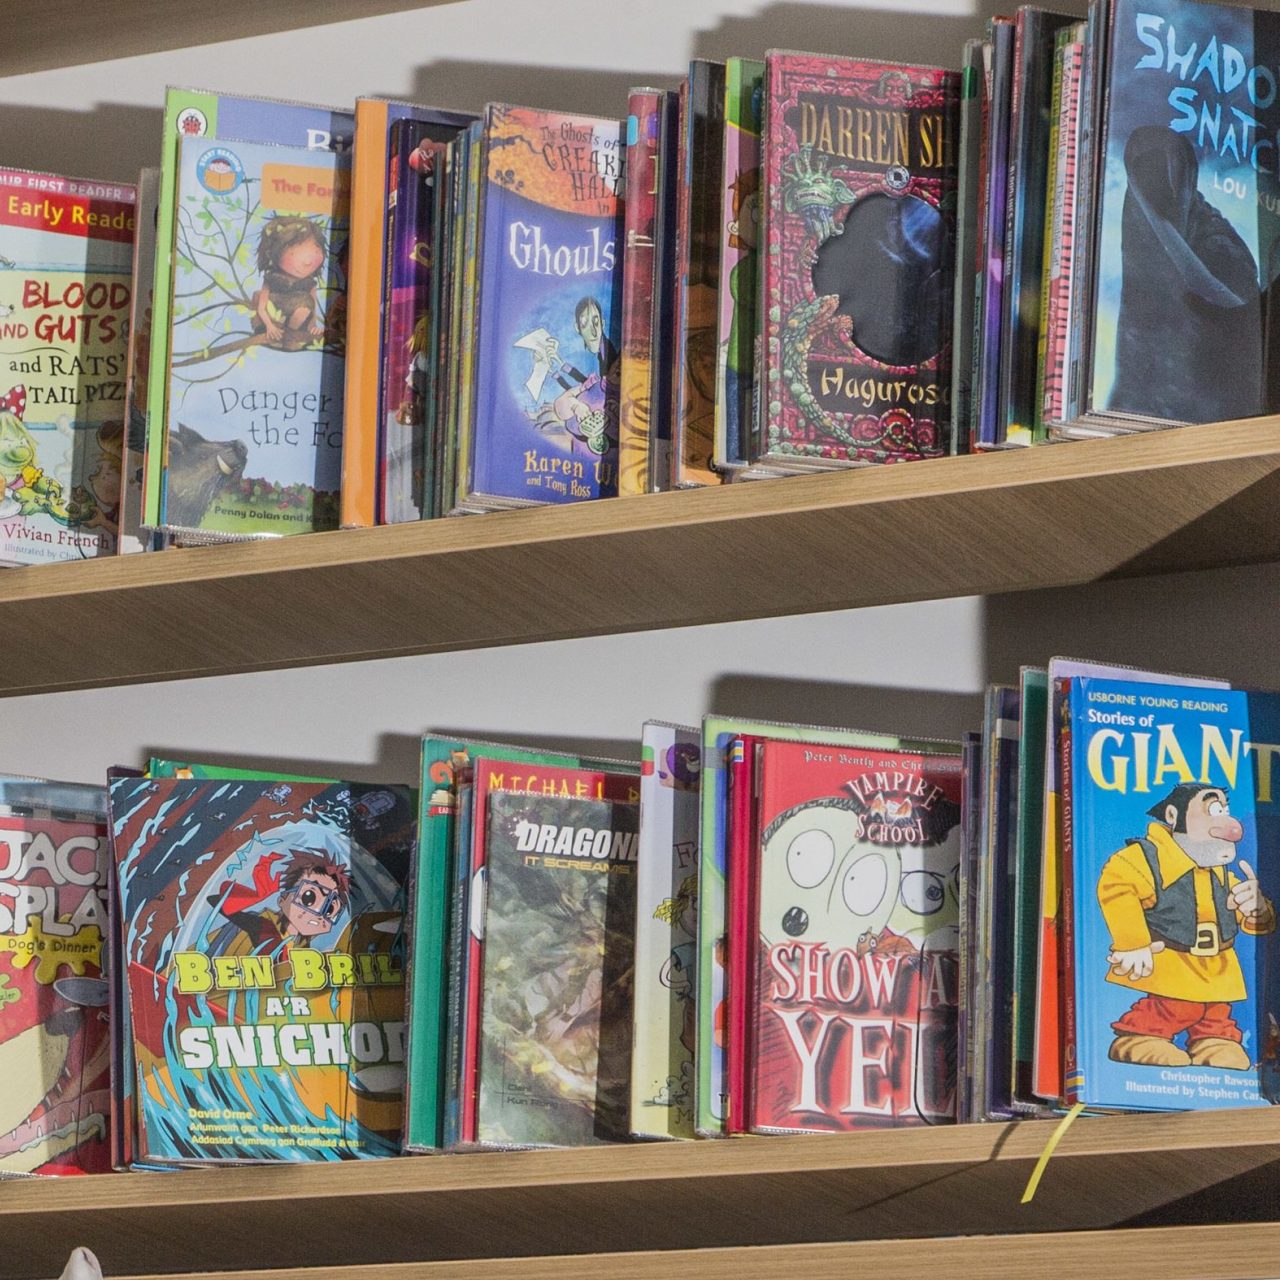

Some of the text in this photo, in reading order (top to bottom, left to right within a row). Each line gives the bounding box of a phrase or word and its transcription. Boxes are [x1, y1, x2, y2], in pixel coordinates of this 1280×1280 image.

[541, 122, 621, 151] The Ghosts of
[800, 101, 910, 167] DARREN
[28, 177, 65, 193] FIRST
[69, 184, 122, 200] READER
[272, 179, 303, 196] The
[1213, 171, 1247, 199] LOU
[8, 195, 136, 231] Early Reade
[509, 221, 617, 277] Ghouls
[22, 279, 130, 311] BLOOD
[34, 313, 117, 345] GUTS
[9, 355, 42, 373] and
[29, 381, 128, 406] TAIL PIZ
[218, 387, 334, 422] Danger
[248, 414, 301, 448] the
[523, 449, 583, 479] Karen
[526, 476, 591, 498] and Tony Ross
[214, 506, 247, 519] Penny
[282, 512, 304, 522] and
[3, 522, 110, 550] Vivian French
[5, 543, 58, 559] Illustrated by
[1088, 692, 1229, 713] USBORNE YOUNG READING
[1088, 709, 1155, 727] Stories of
[803, 750, 898, 769] Peter Bently and
[1062, 740, 1071, 786] Stories
[489, 772, 605, 801] MICHAEL
[846, 772, 944, 811] VAMPIRE
[854, 813, 929, 845] SCHOOL
[1063, 806, 1072, 852] GIANTS
[523, 856, 631, 874] IT SCREAMS
[455, 903, 463, 942] HAMSTER
[8, 937, 97, 955] Dog's Dinner
[174, 948, 405, 994] BEN BRIL
[770, 942, 902, 1008] SHOW
[265, 996, 312, 1017] A'R
[453, 975, 461, 1027] ASTRONAUT
[1125, 1081, 1240, 1102] Illustrated by Stephen
[1160, 1071, 1261, 1087] Christopher Rawson
[188, 1108, 252, 1120] David Orme
[192, 1135, 233, 1145] Addasiad
[278, 1138, 296, 1148] gan
[241, 1125, 258, 1136] gan
[262, 1123, 288, 1134] Peter
[291, 1124, 341, 1135] Richardson
